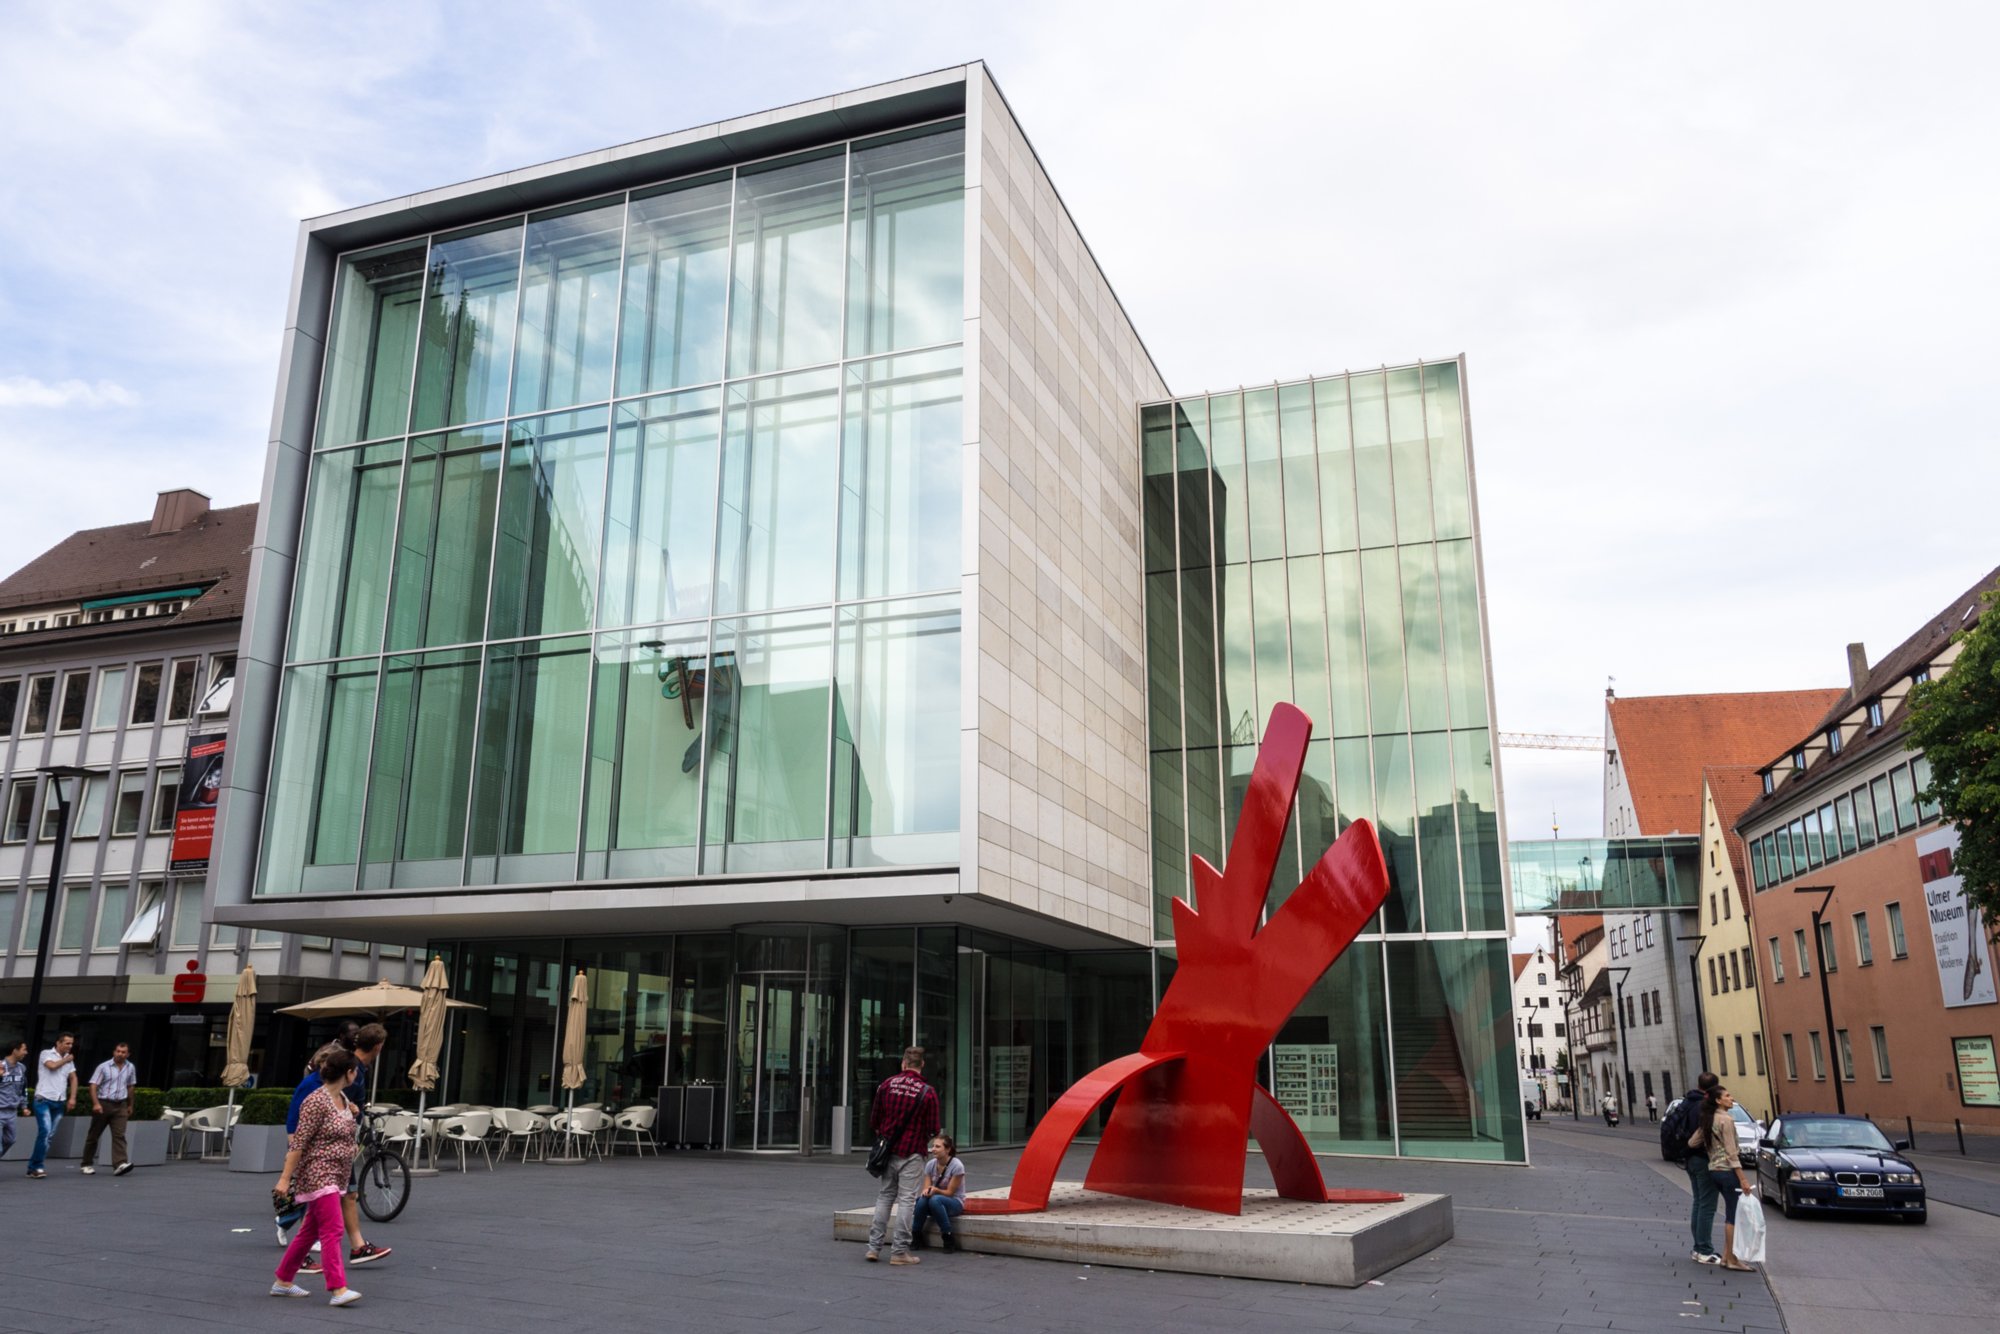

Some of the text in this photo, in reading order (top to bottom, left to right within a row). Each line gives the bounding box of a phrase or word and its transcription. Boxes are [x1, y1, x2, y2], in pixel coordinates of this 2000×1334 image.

[1926, 889, 1951, 907] Ulmer
[1929, 905, 1964, 925] Museum
[1934, 931, 1959, 945] Tradition
[1940, 957, 1964, 969] Moderne
